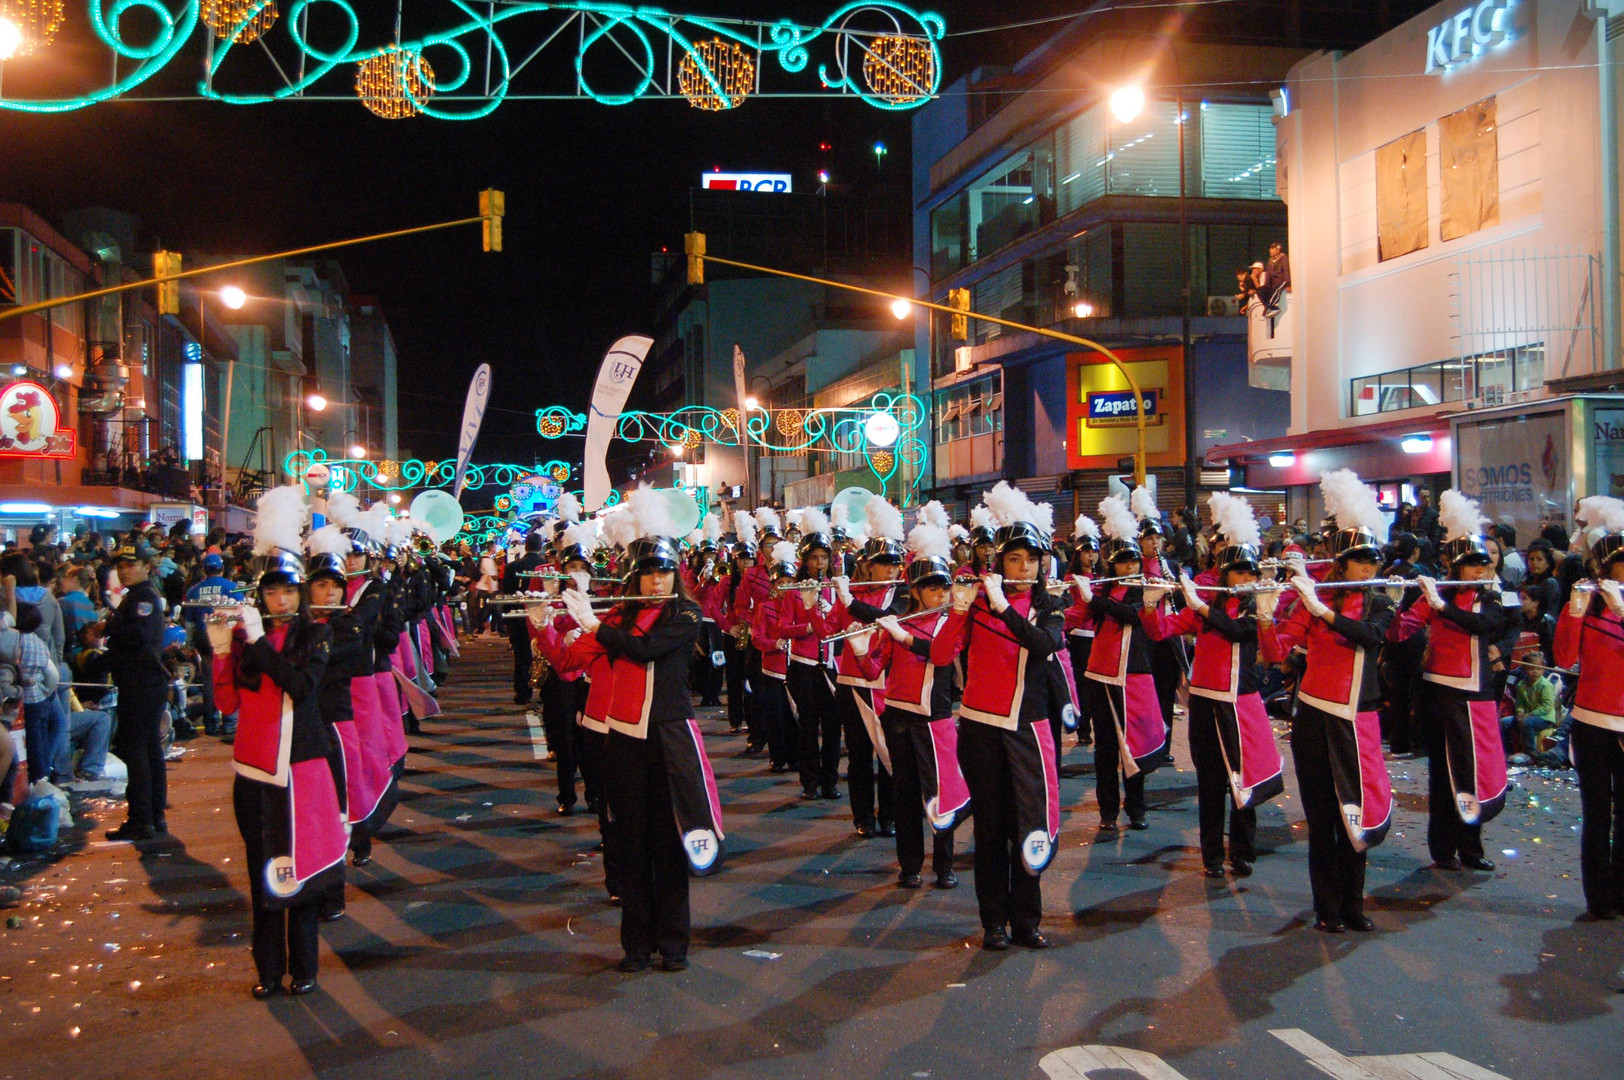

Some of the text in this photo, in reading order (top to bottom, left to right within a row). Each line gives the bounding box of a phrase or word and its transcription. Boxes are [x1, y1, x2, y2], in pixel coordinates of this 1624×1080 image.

[1424, 0, 1500, 75] KFC
[1465, 462, 1532, 489] SOMOS
[199, 586, 212, 595] LUZ
